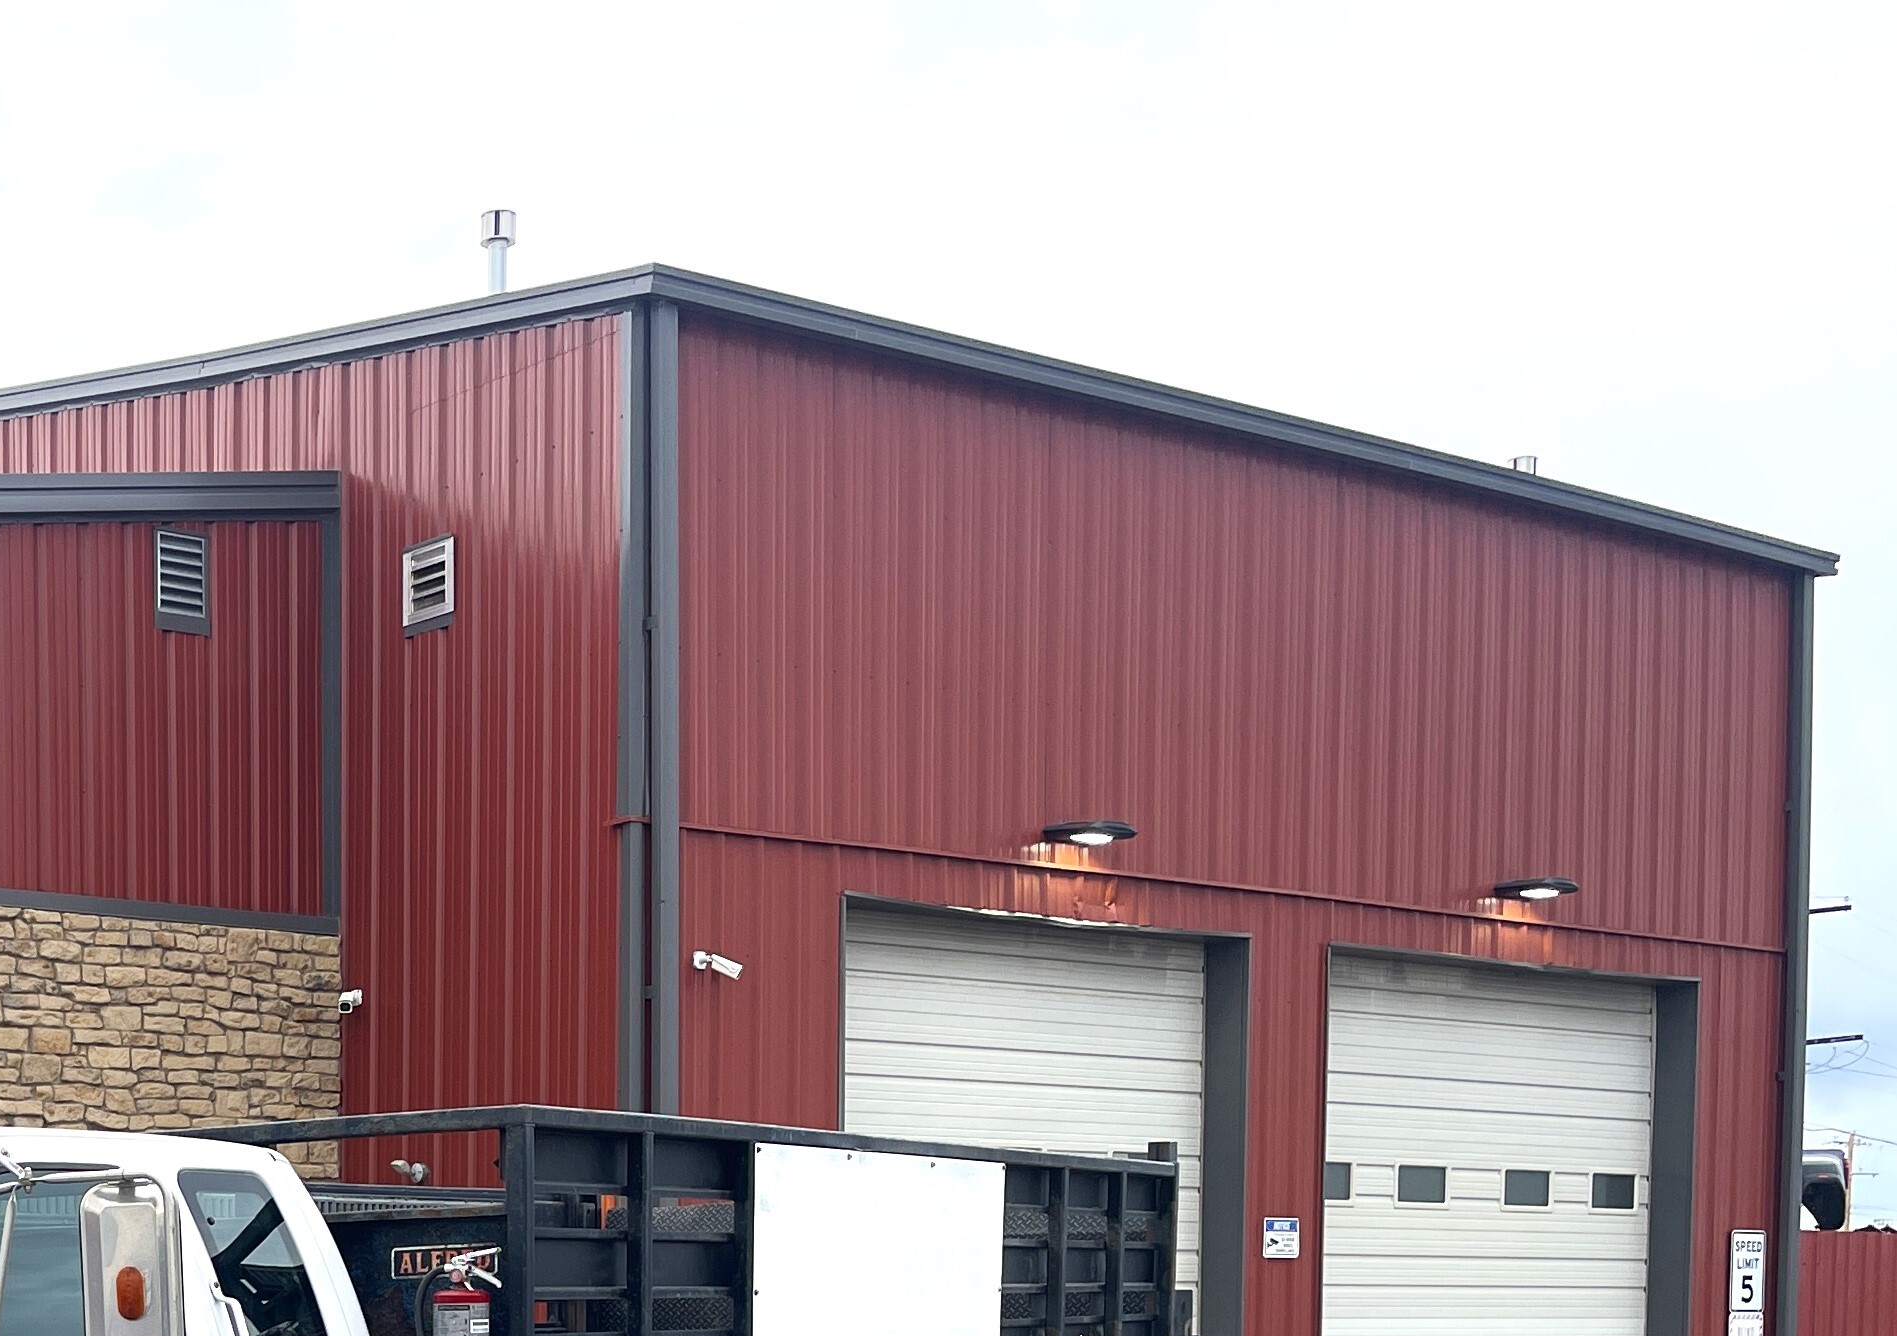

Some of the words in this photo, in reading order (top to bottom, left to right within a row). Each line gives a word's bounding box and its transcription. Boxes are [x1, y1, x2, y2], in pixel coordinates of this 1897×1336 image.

[1735, 1241, 1763, 1253] SPEED
[400, 1249, 491, 1274] ALFD
[1737, 1258, 1760, 1270] LIMIT
[1741, 1275, 1753, 1303] 5
